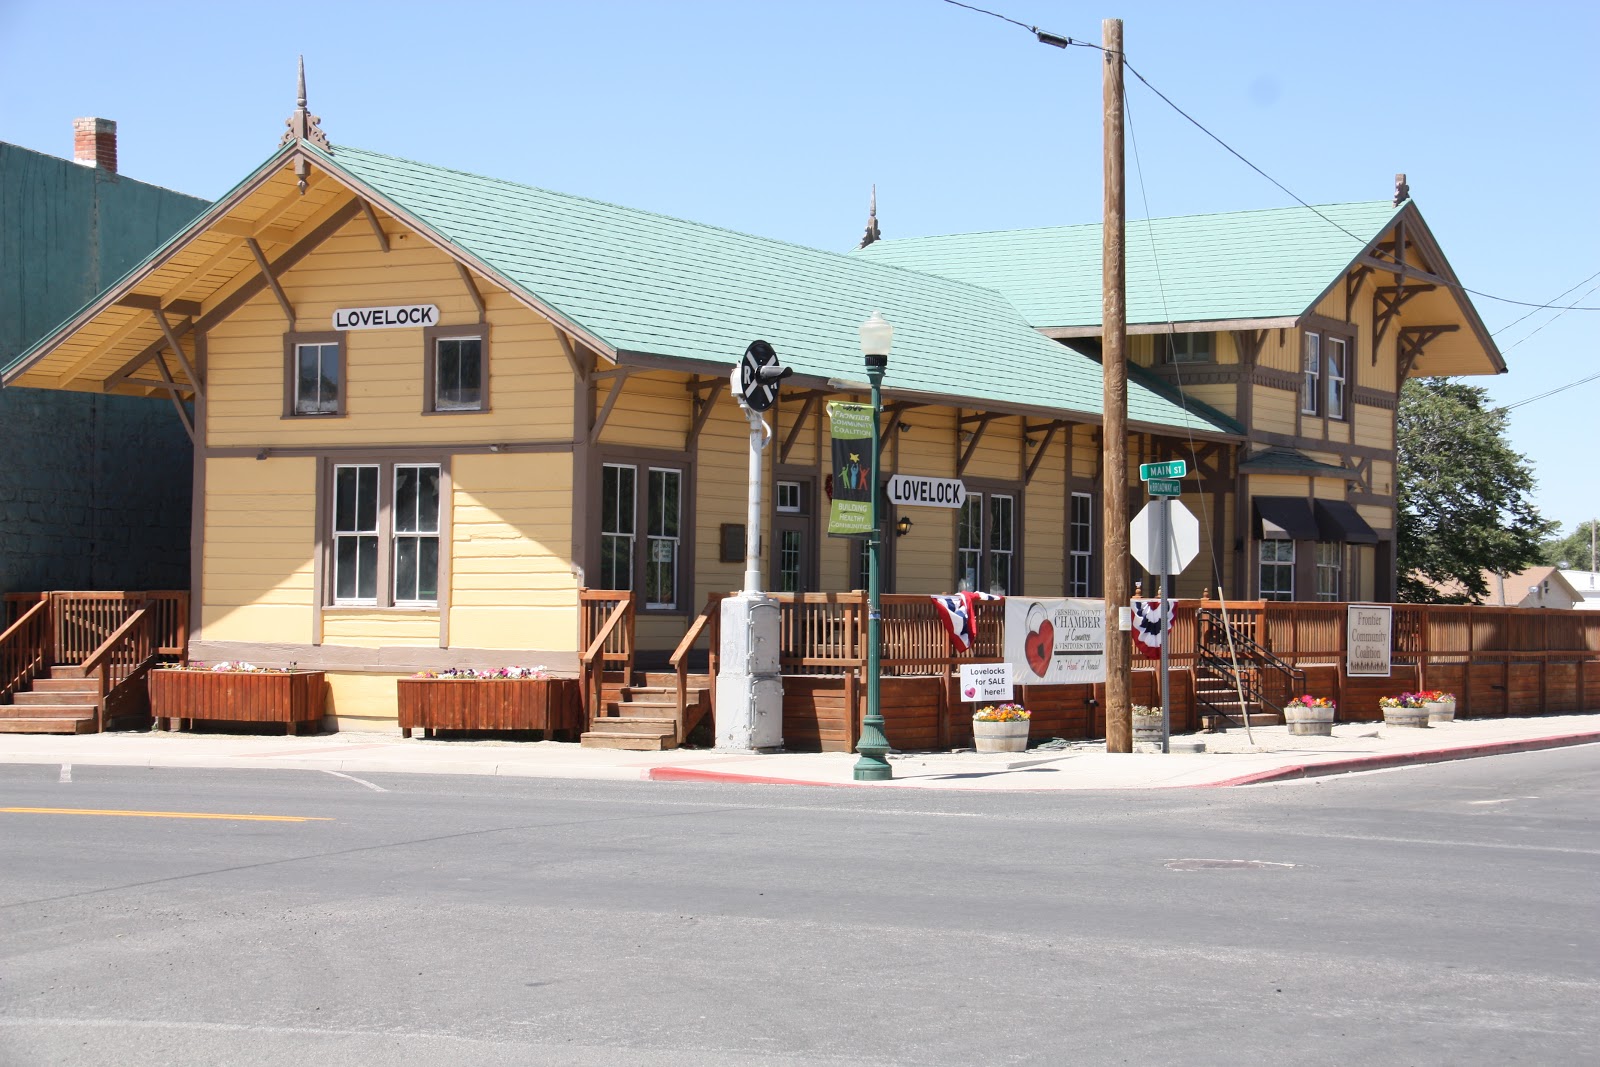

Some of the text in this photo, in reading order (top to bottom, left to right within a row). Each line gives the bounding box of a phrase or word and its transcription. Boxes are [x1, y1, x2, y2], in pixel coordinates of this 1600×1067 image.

[336, 307, 432, 327] LOVELOCK
[834, 410, 870, 421] FRONTIER
[831, 417, 873, 428] COMMUNITY
[834, 426, 871, 436] COALITION
[1150, 465, 1182, 476] MAIN ST
[894, 479, 960, 504] LOVELOCK
[1152, 482, 1172, 492] BROADWAY
[838, 503, 867, 512] BUILDING
[840, 513, 865, 522] HEALTHY
[830, 521, 872, 529] COMMUNITIES
[1080, 609, 1102, 617] COUNTY
[1054, 616, 1101, 628] CHAMBER
[1357, 612, 1382, 626] Frontier
[1352, 629, 1387, 646] Community
[1355, 645, 1381, 659] Coalition
